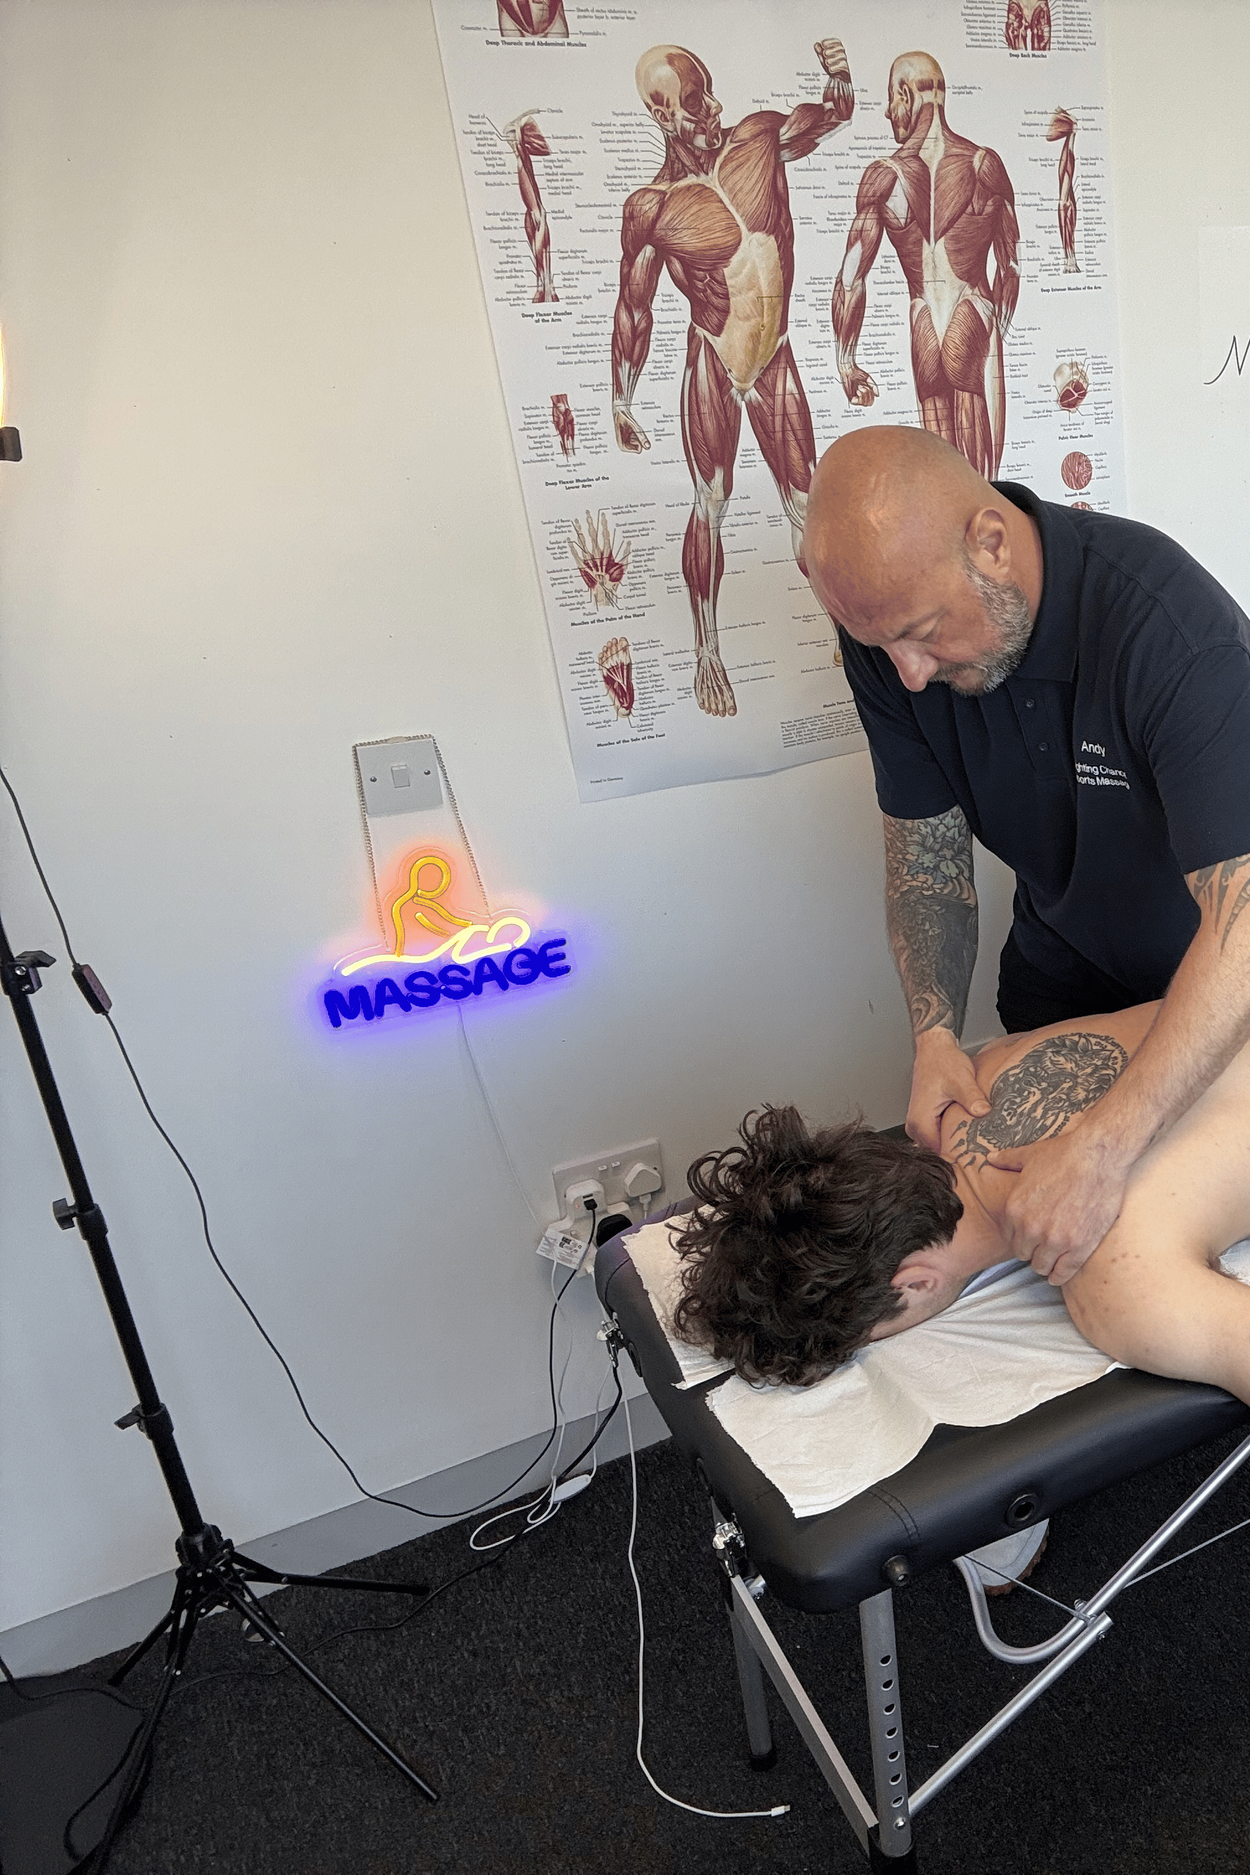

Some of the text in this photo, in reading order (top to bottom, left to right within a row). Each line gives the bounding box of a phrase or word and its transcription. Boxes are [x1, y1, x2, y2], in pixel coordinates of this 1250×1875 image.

[1081, 740, 1106, 757] Andy
[1076, 762, 1100, 776] ghting
[324, 937, 572, 1028] MASSAGE
